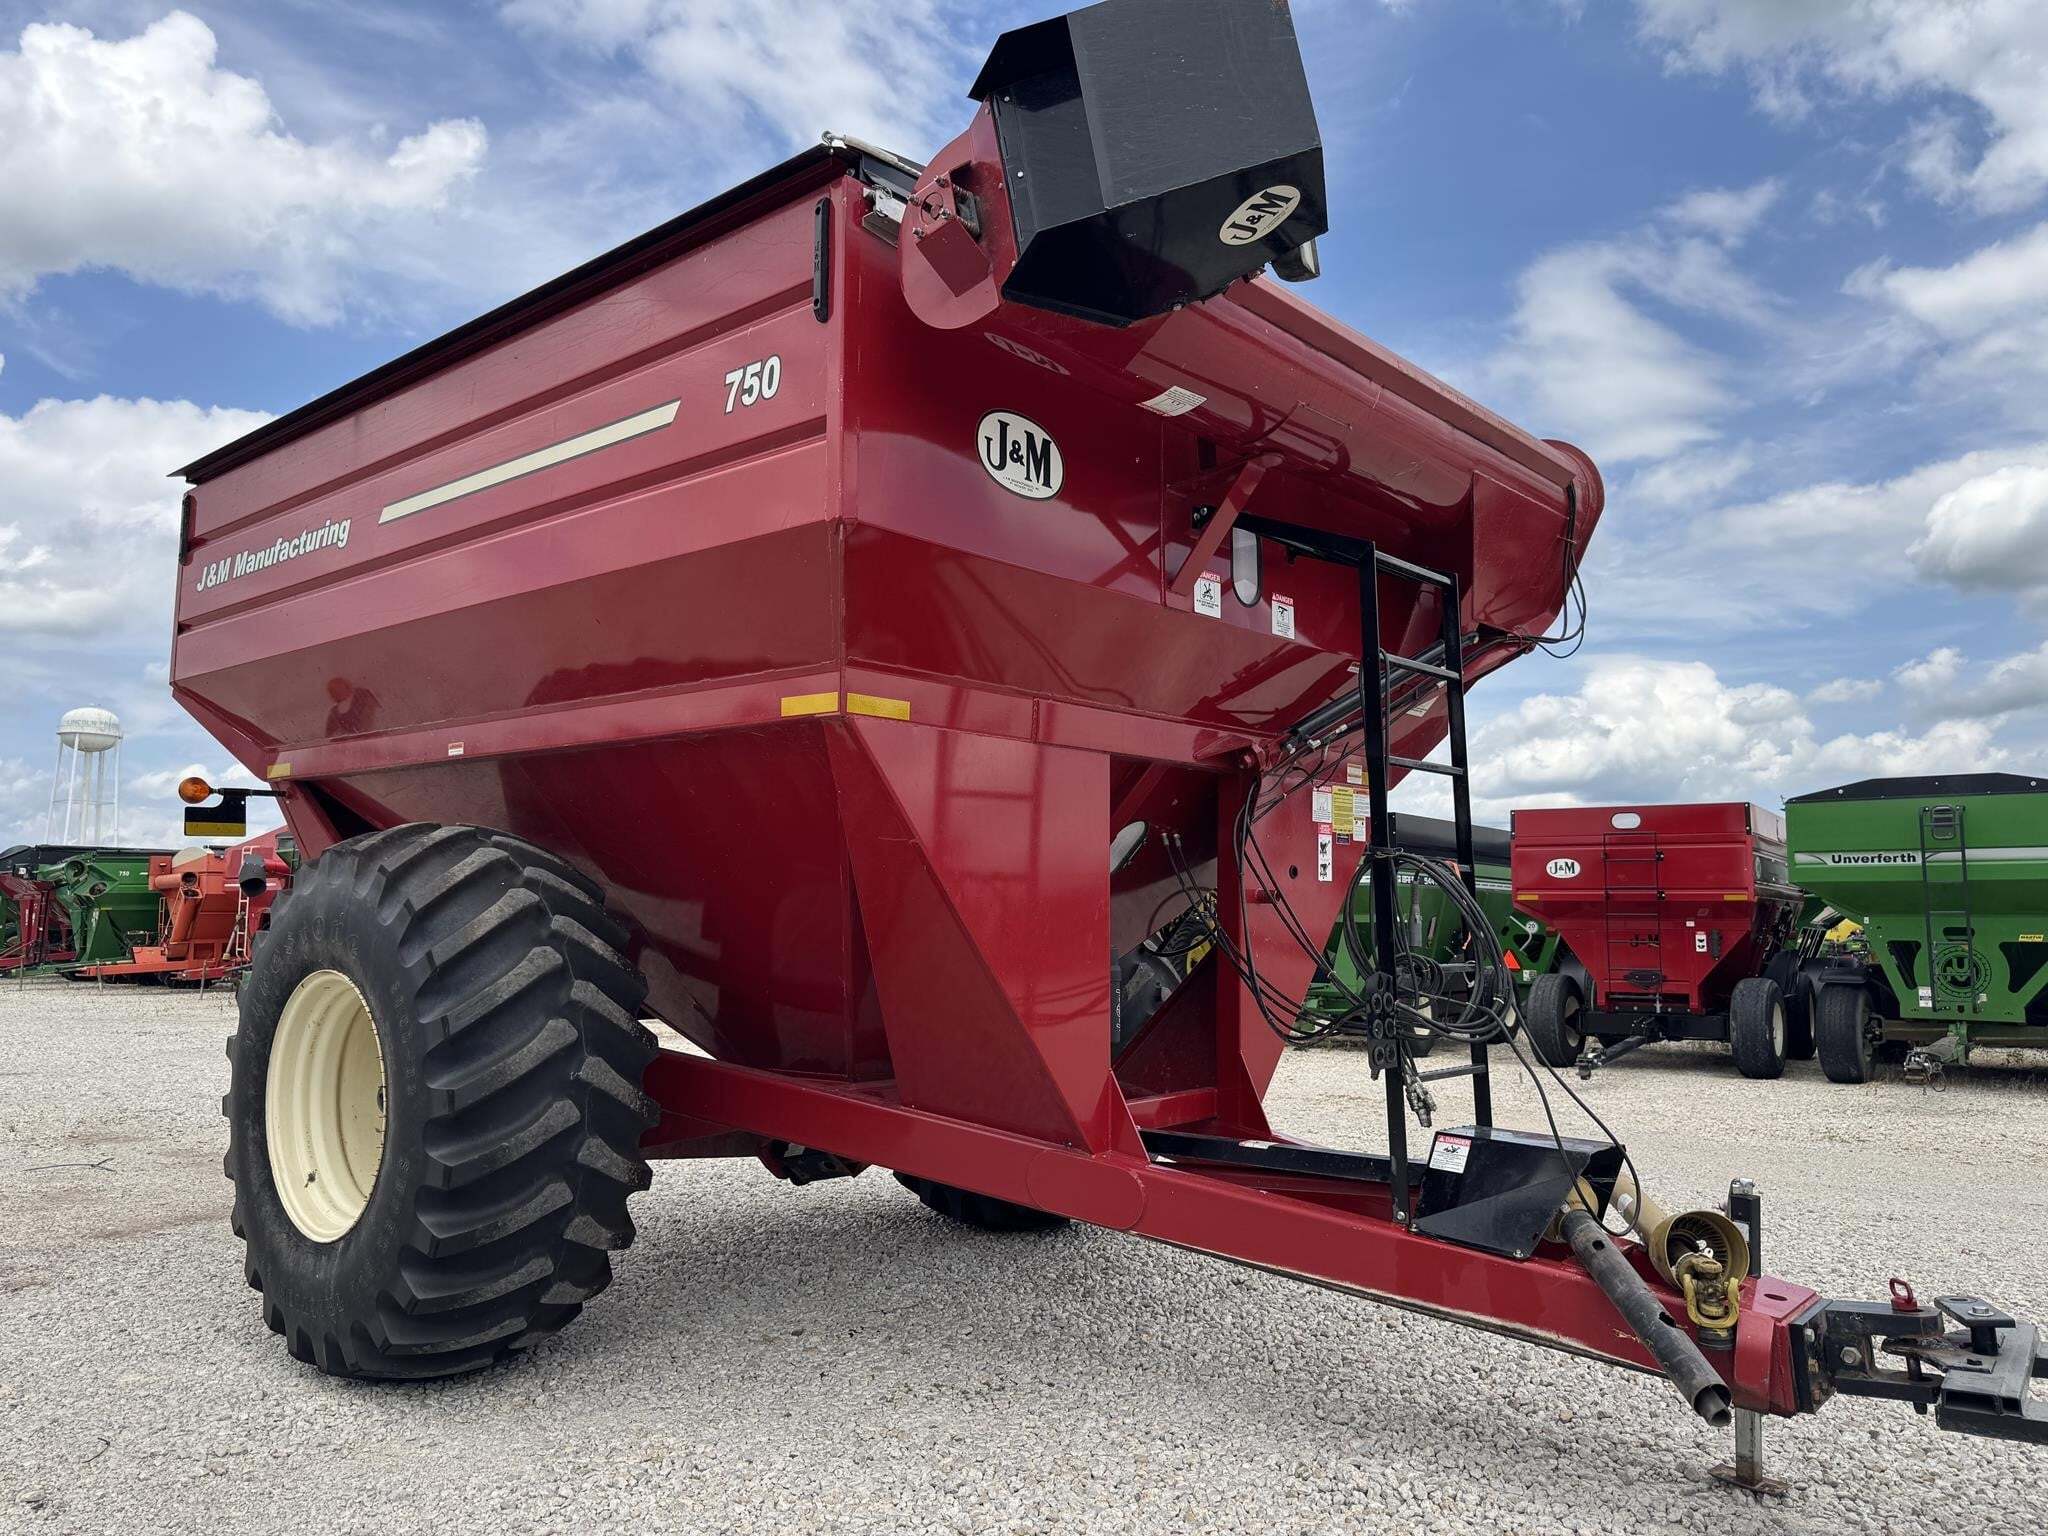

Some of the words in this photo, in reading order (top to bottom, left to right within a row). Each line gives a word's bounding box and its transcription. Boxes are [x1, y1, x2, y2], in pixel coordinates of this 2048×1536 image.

[1226, 190, 1295, 241] J&M
[724, 354, 782, 415] 750
[984, 418, 1053, 489] J&M
[196, 556, 232, 592] J&M
[232, 518, 352, 579] Manufacturing
[1549, 861, 1576, 875] J&M
[1831, 853, 1917, 864] Unverferth
